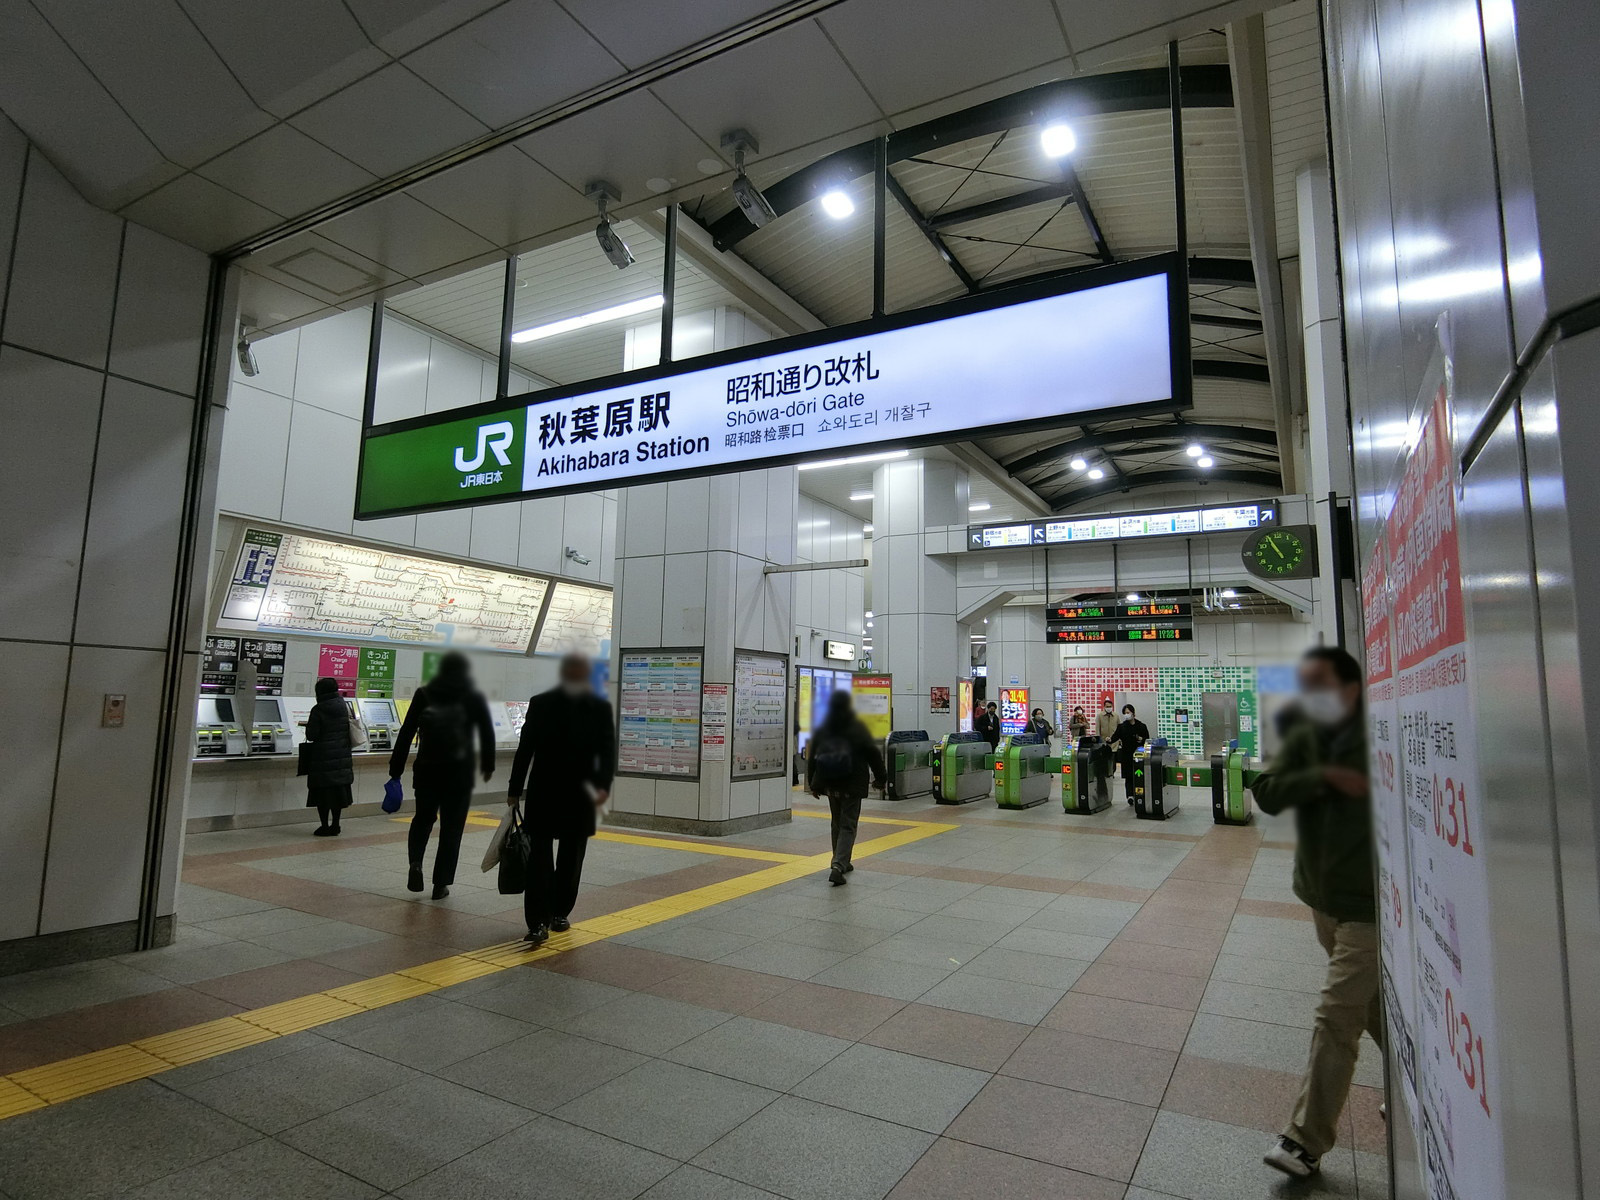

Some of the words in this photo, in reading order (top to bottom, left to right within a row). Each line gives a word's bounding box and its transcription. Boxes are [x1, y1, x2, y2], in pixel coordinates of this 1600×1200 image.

[727, 350, 880, 404] 昭和通り改札
[726, 398, 817, 427] Shōwa-dōri
[823, 392, 864, 410] Gate
[818, 410, 878, 433] 쇼와도리
[885, 402, 932, 423] 개찰구
[538, 391, 671, 450] 秋葉原駅
[454, 420, 514, 472] JR
[725, 423, 804, 448] 昭和路检票口
[537, 448, 629, 477] Akihabara
[636, 436, 709, 462] Station
[460, 470, 503, 488] JR東日本
[217, 639, 237, 649] 定期券
[245, 641, 263, 651] きっぷ
[265, 643, 283, 653] 定期券
[321, 647, 359, 658] チャージ専用
[367, 650, 389, 660] きっぷ
[1002, 701, 1026, 711] 大きい
[1002, 711, 1026, 719] サイズ
[995, 762, 1004, 770] IC
[1062, 766, 1071, 774] IC
[1433, 773, 1473, 856] 0:31
[1445, 987, 1491, 1119] 0:31
